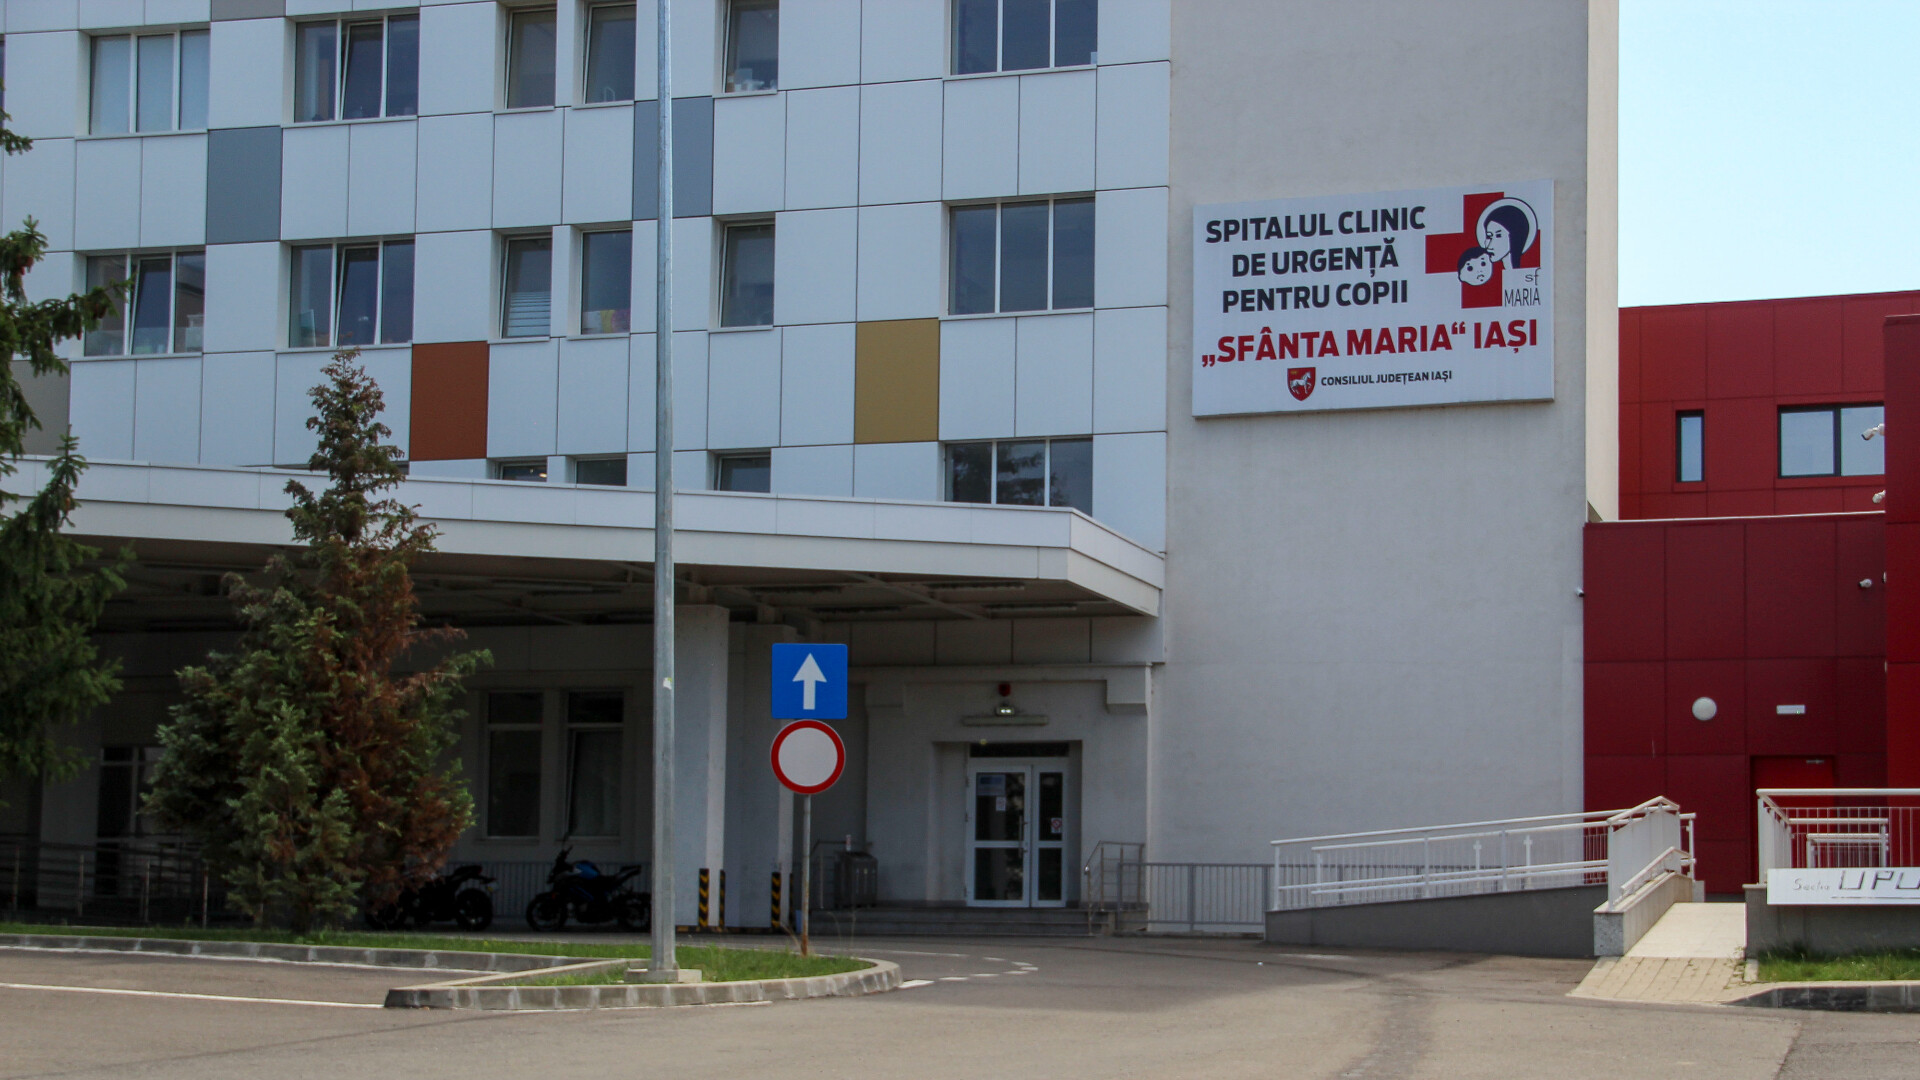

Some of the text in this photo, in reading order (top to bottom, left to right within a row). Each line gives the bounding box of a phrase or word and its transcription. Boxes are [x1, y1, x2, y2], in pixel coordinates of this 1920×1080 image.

[1205, 206, 1426, 243] SPITALUL CLINIC
[1232, 237, 1399, 278] DE URGENȚĂ
[1222, 280, 1408, 313] PENTRU COPII
[1504, 287, 1541, 307] MARIA
[1473, 319, 1537, 354] IAȘI
[1321, 370, 1452, 386] CONSILIUL JUDEȚEAN IAȘI
